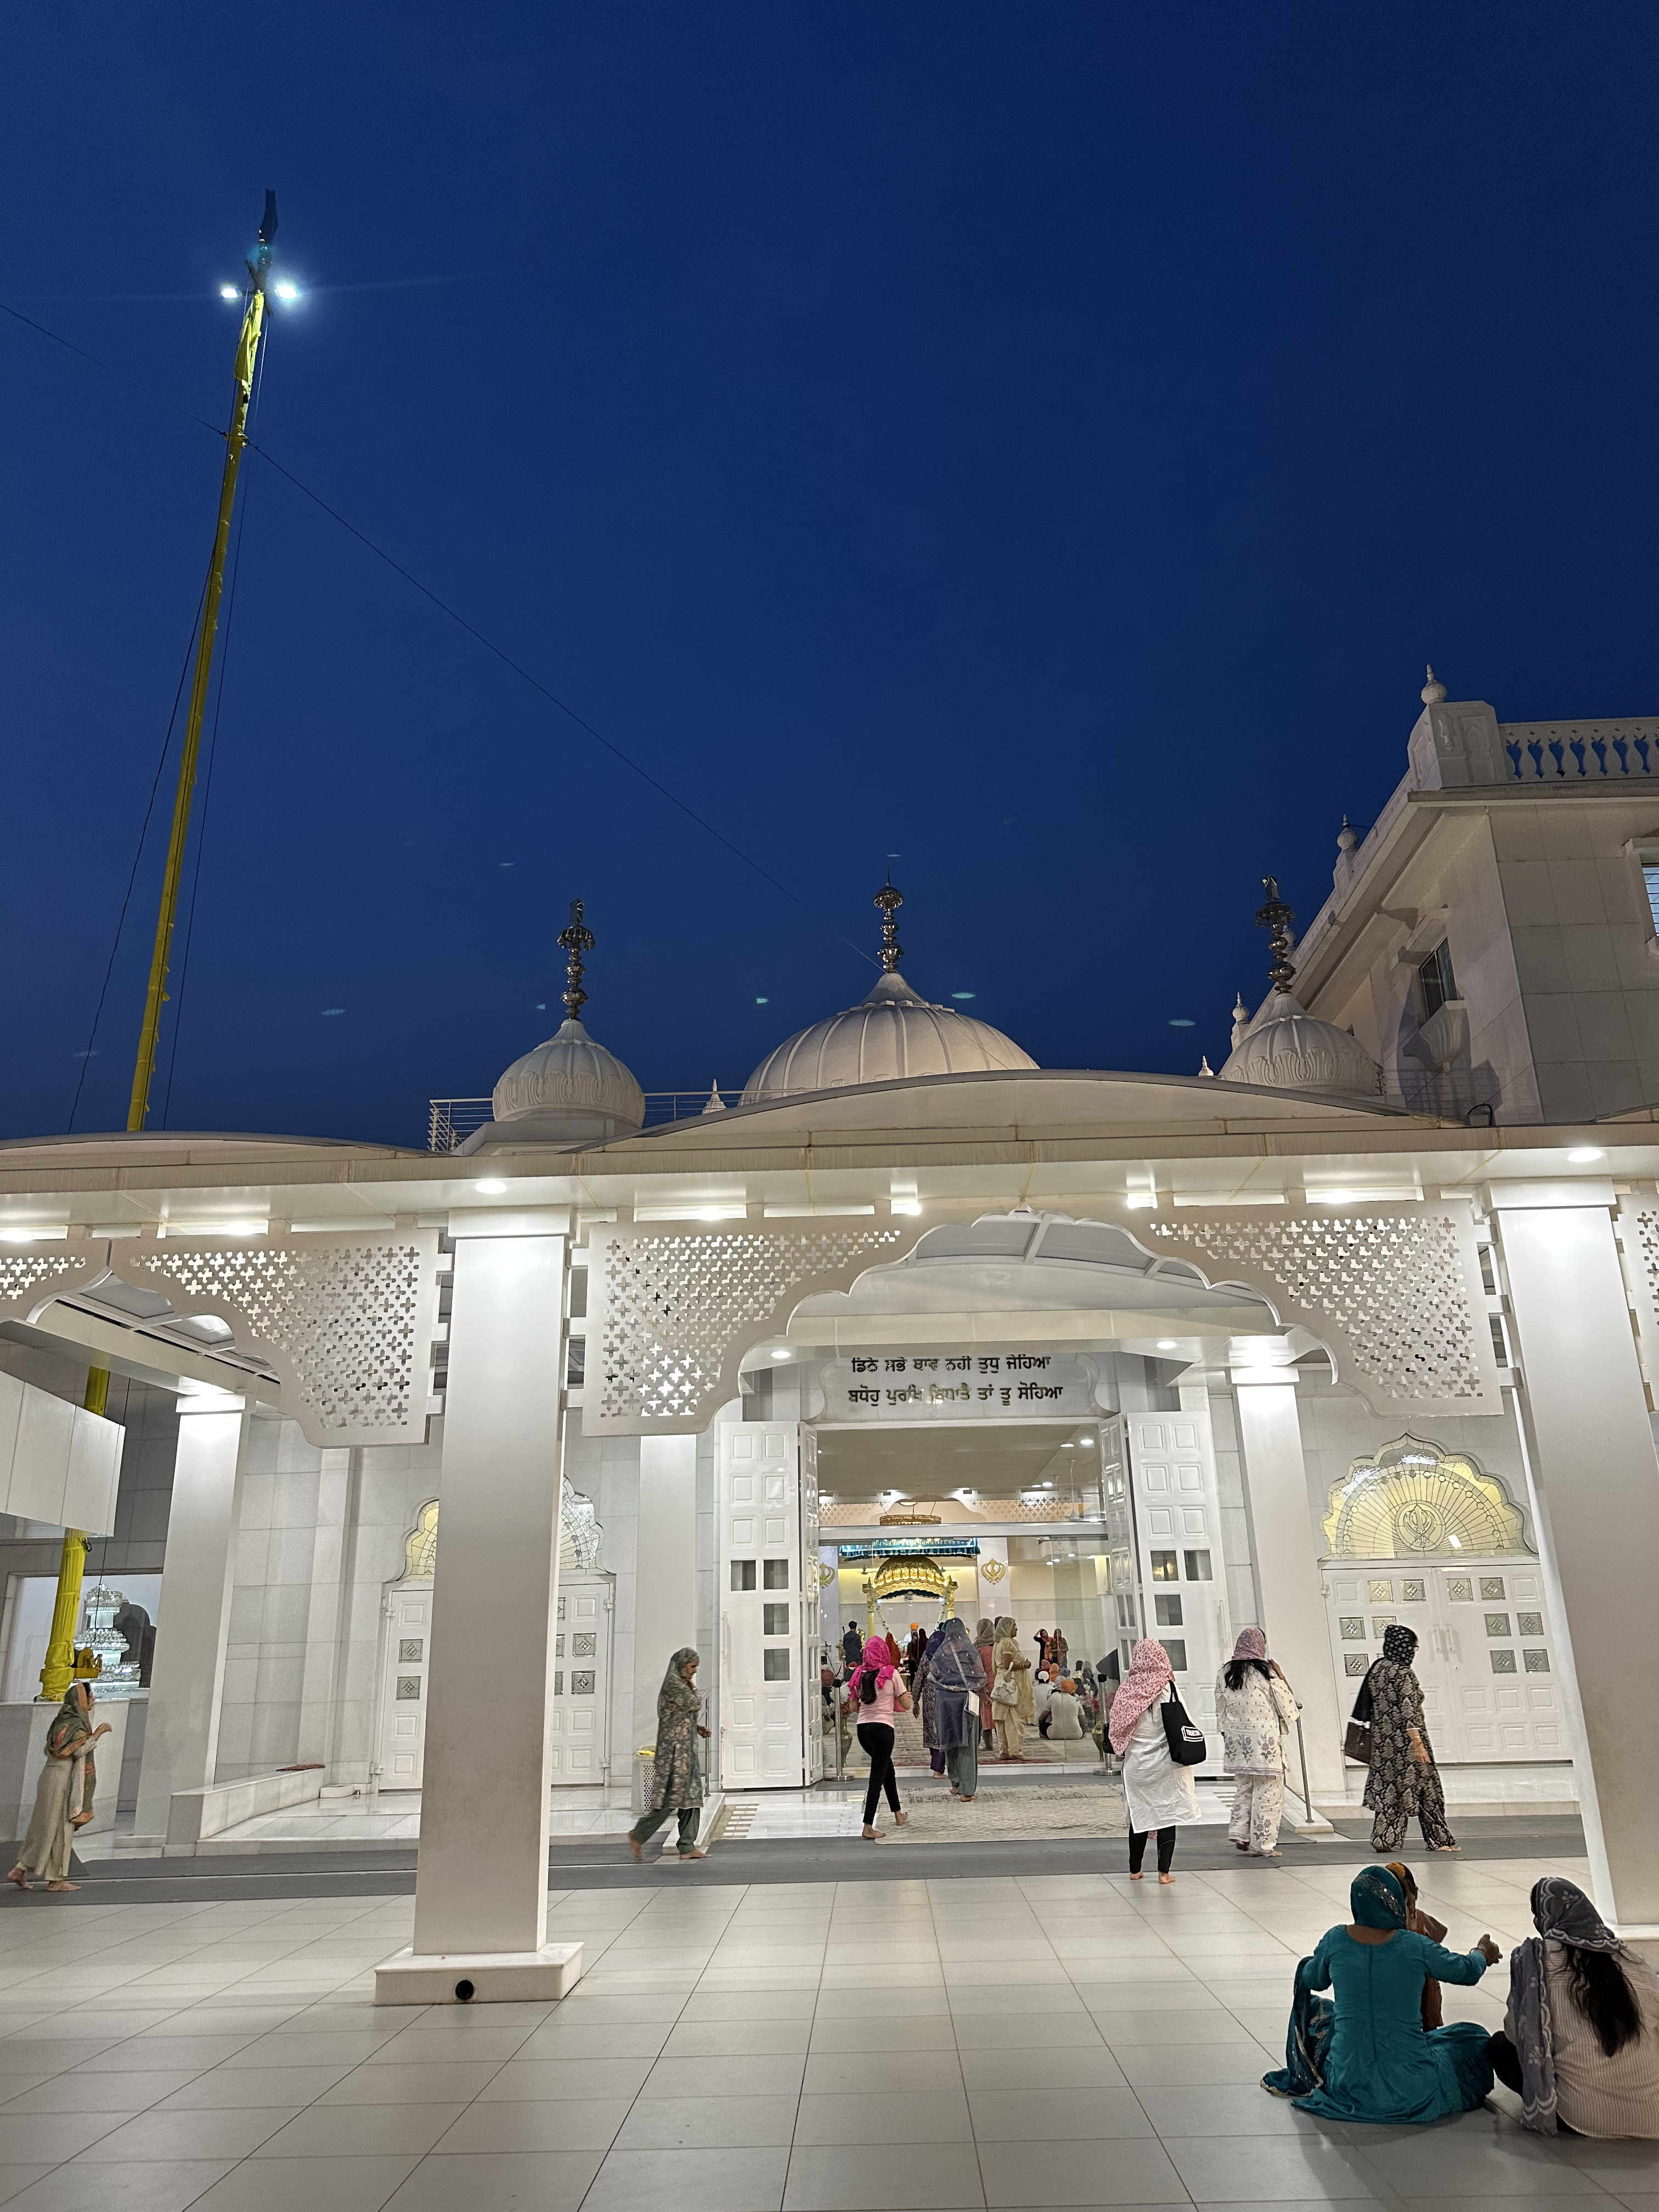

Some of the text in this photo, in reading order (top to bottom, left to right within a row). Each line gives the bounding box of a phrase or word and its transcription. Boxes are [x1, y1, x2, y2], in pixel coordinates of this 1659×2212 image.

[885, 1357, 907, 1372] ਸਭੇ
[978, 1384, 994, 1400] ਤਾਂ
[1000, 1387, 1012, 1406] ਤੂ
[1018, 1381, 1063, 1400] ਸੋਹਿਆ
